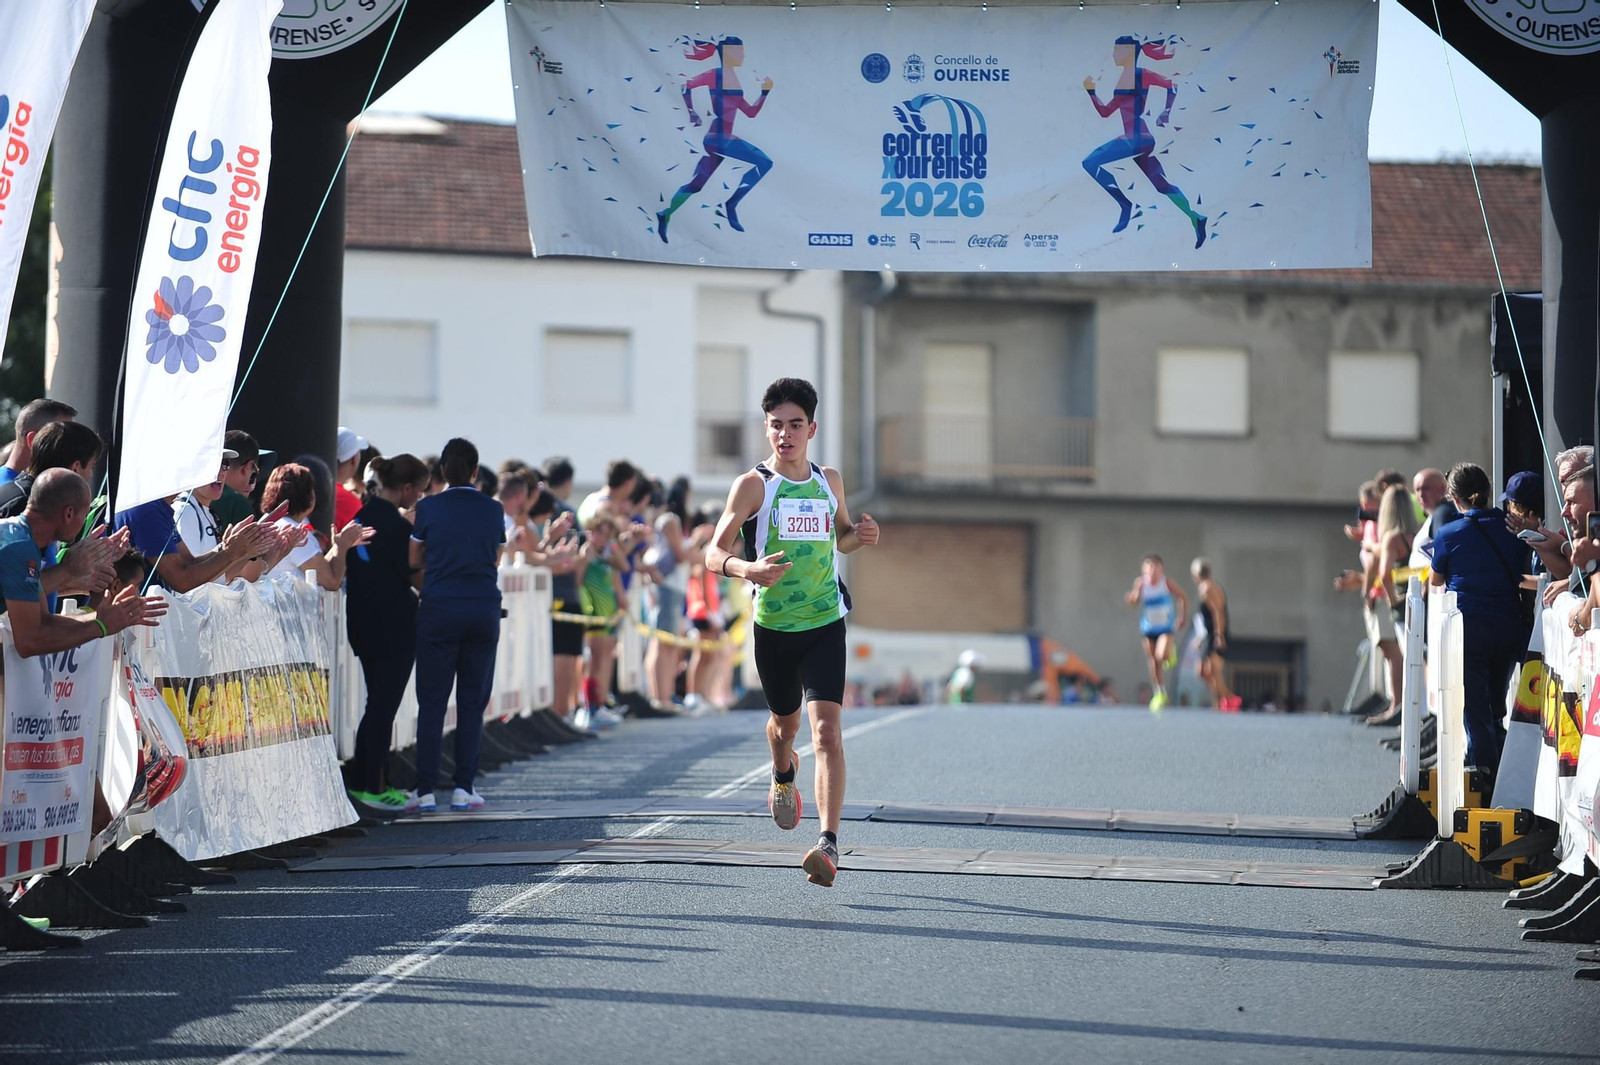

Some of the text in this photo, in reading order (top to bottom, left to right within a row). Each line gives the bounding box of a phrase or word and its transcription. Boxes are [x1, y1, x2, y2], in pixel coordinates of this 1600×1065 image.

[1516, 15, 1600, 42] OURENS
[934, 55, 998, 65] Concello de
[934, 69, 1010, 82] OURENSE
[882, 133, 988, 157] correndo
[162, 130, 224, 261] chc
[881, 181, 985, 218] 2026
[218, 145, 260, 273] energía
[810, 235, 852, 245] GADIS
[880, 233, 896, 243] chc
[1023, 233, 1059, 242] Apersa
[788, 517, 819, 533] 3203
